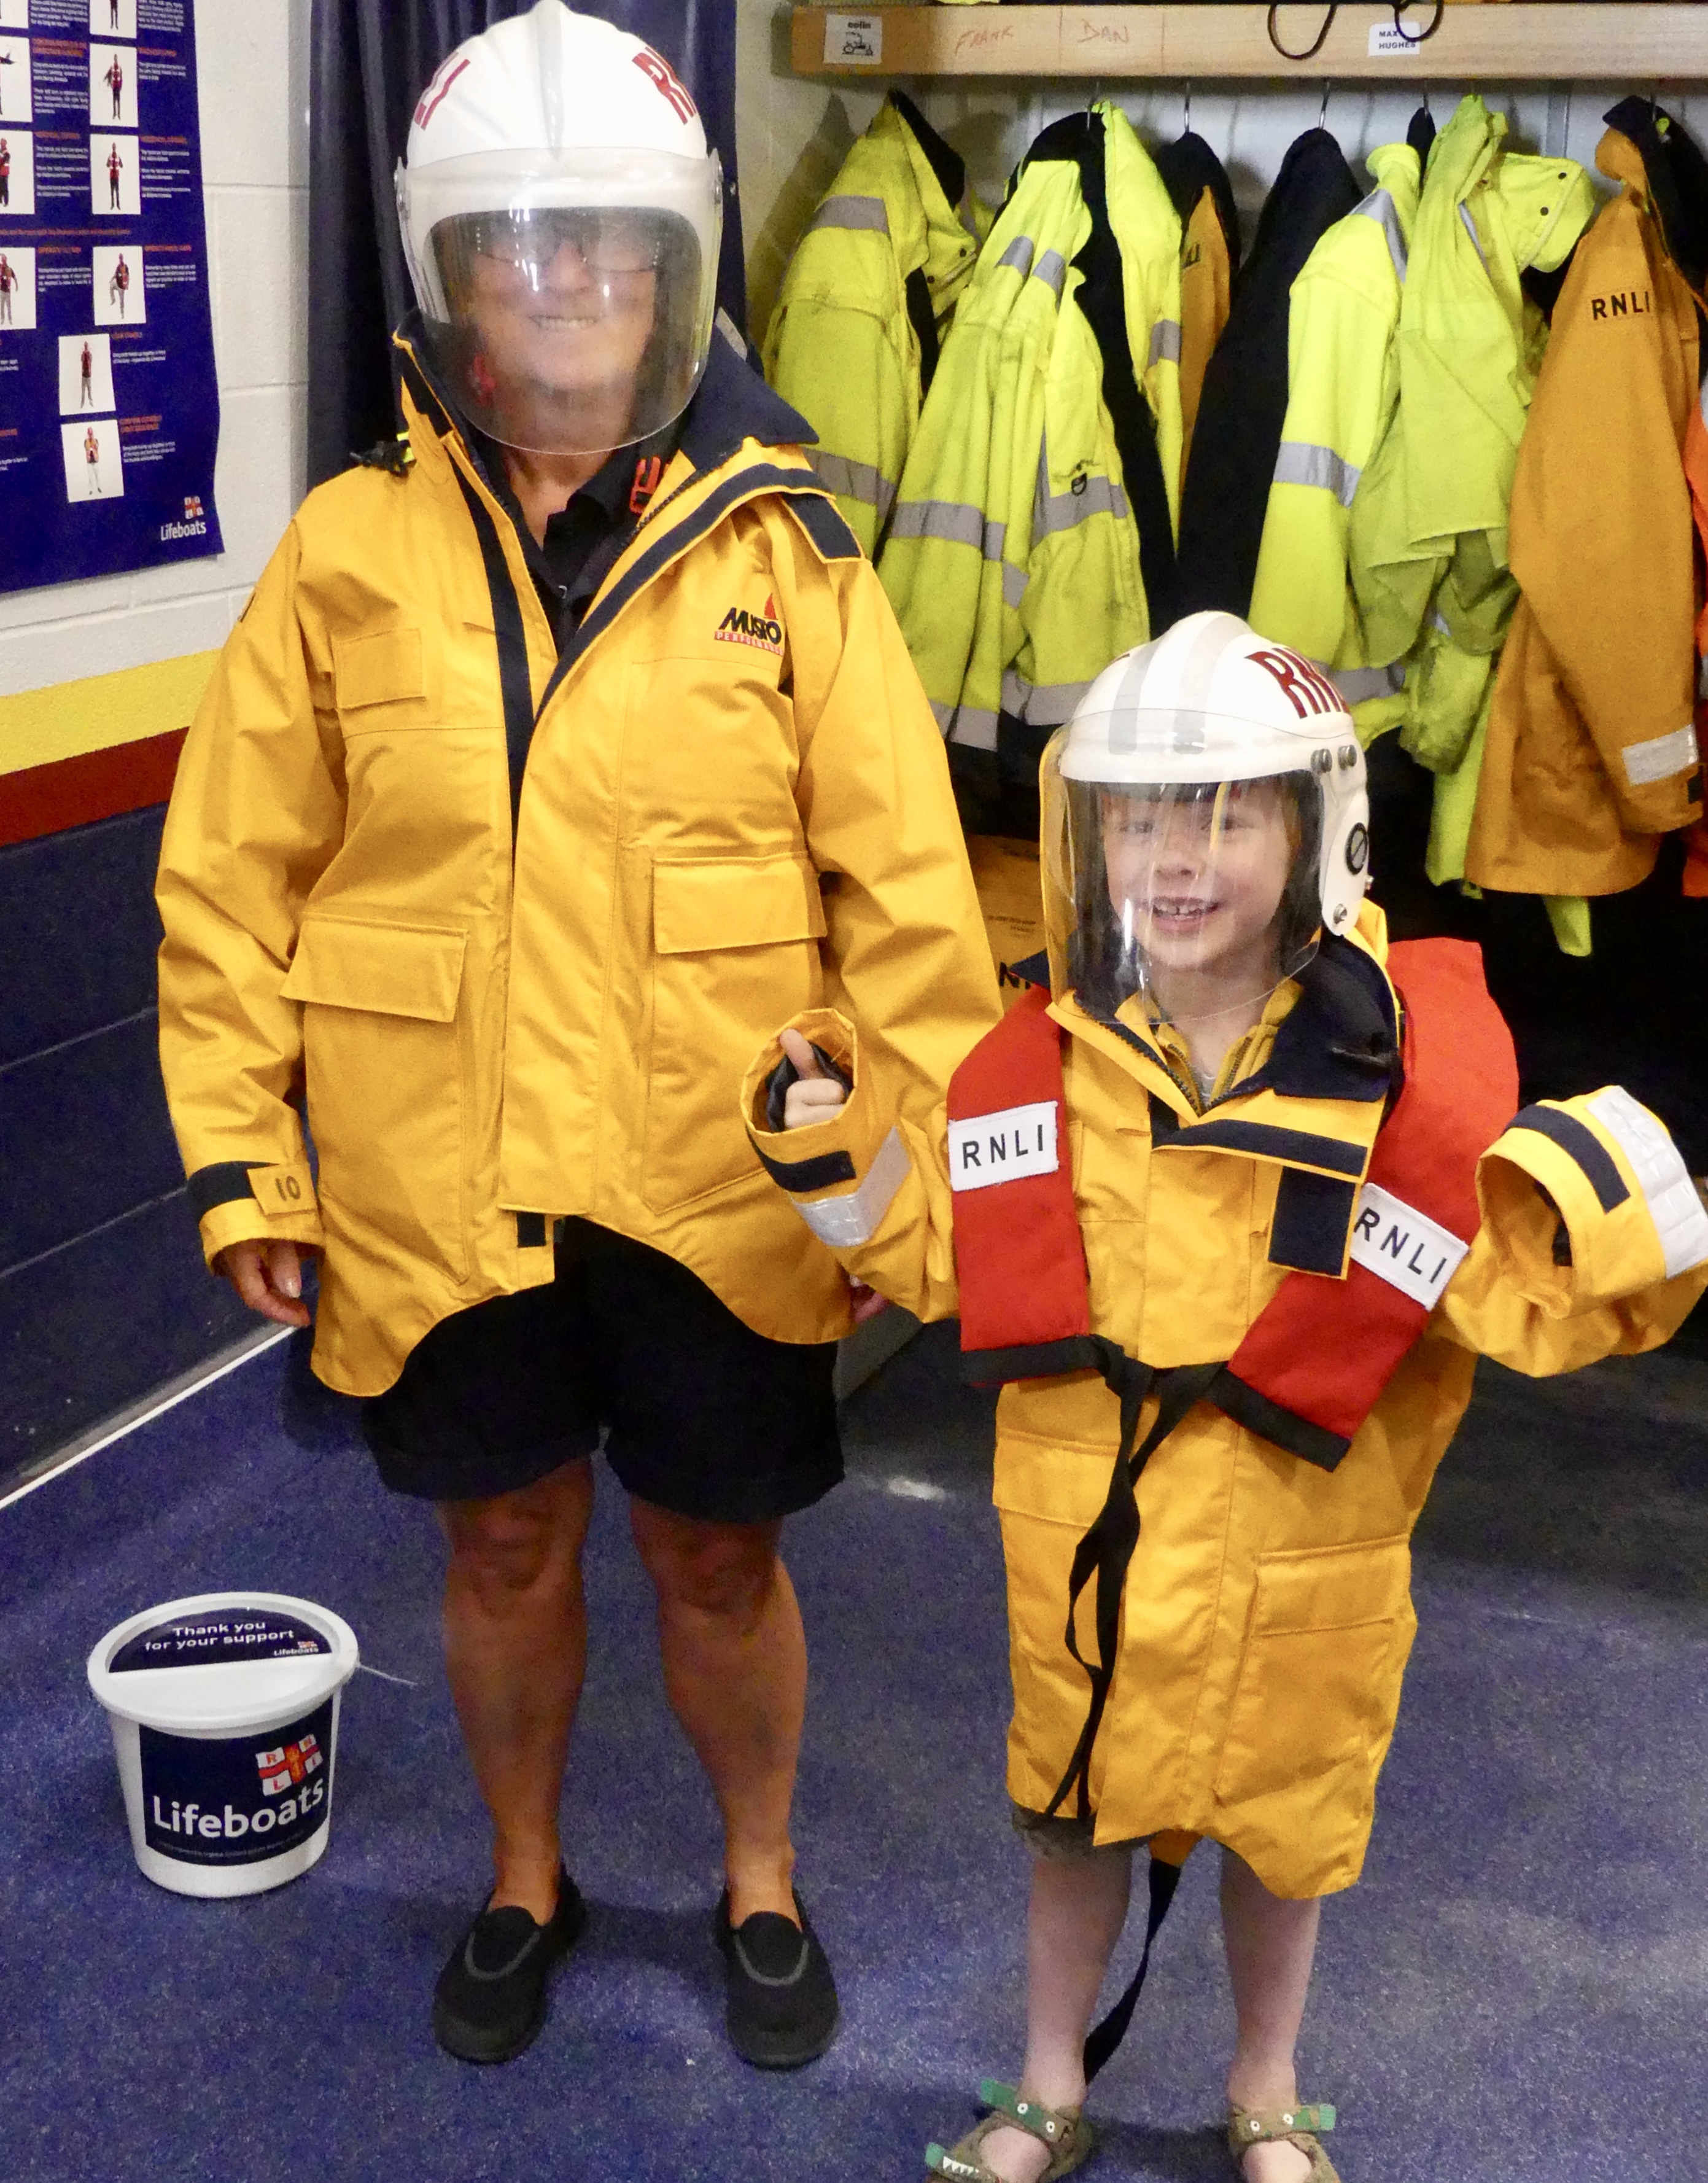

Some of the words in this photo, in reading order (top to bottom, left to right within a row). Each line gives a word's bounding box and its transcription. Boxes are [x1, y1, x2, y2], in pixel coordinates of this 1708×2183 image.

[1077, 18, 1128, 43] DAN
[1591, 291, 1650, 321] RNLI
[160, 520, 207, 541] Lifeboats
[962, 1124, 1043, 1169] RNLI
[275, 1175, 301, 1202] 10
[1353, 1207, 1448, 1284] RNLI
[145, 1641, 171, 1651] for
[176, 1636, 219, 1650] your
[223, 1630, 295, 1644] support
[173, 1624, 229, 1636] Thank
[234, 1622, 266, 1633] you
[153, 1778, 324, 1838] Lifeboats
